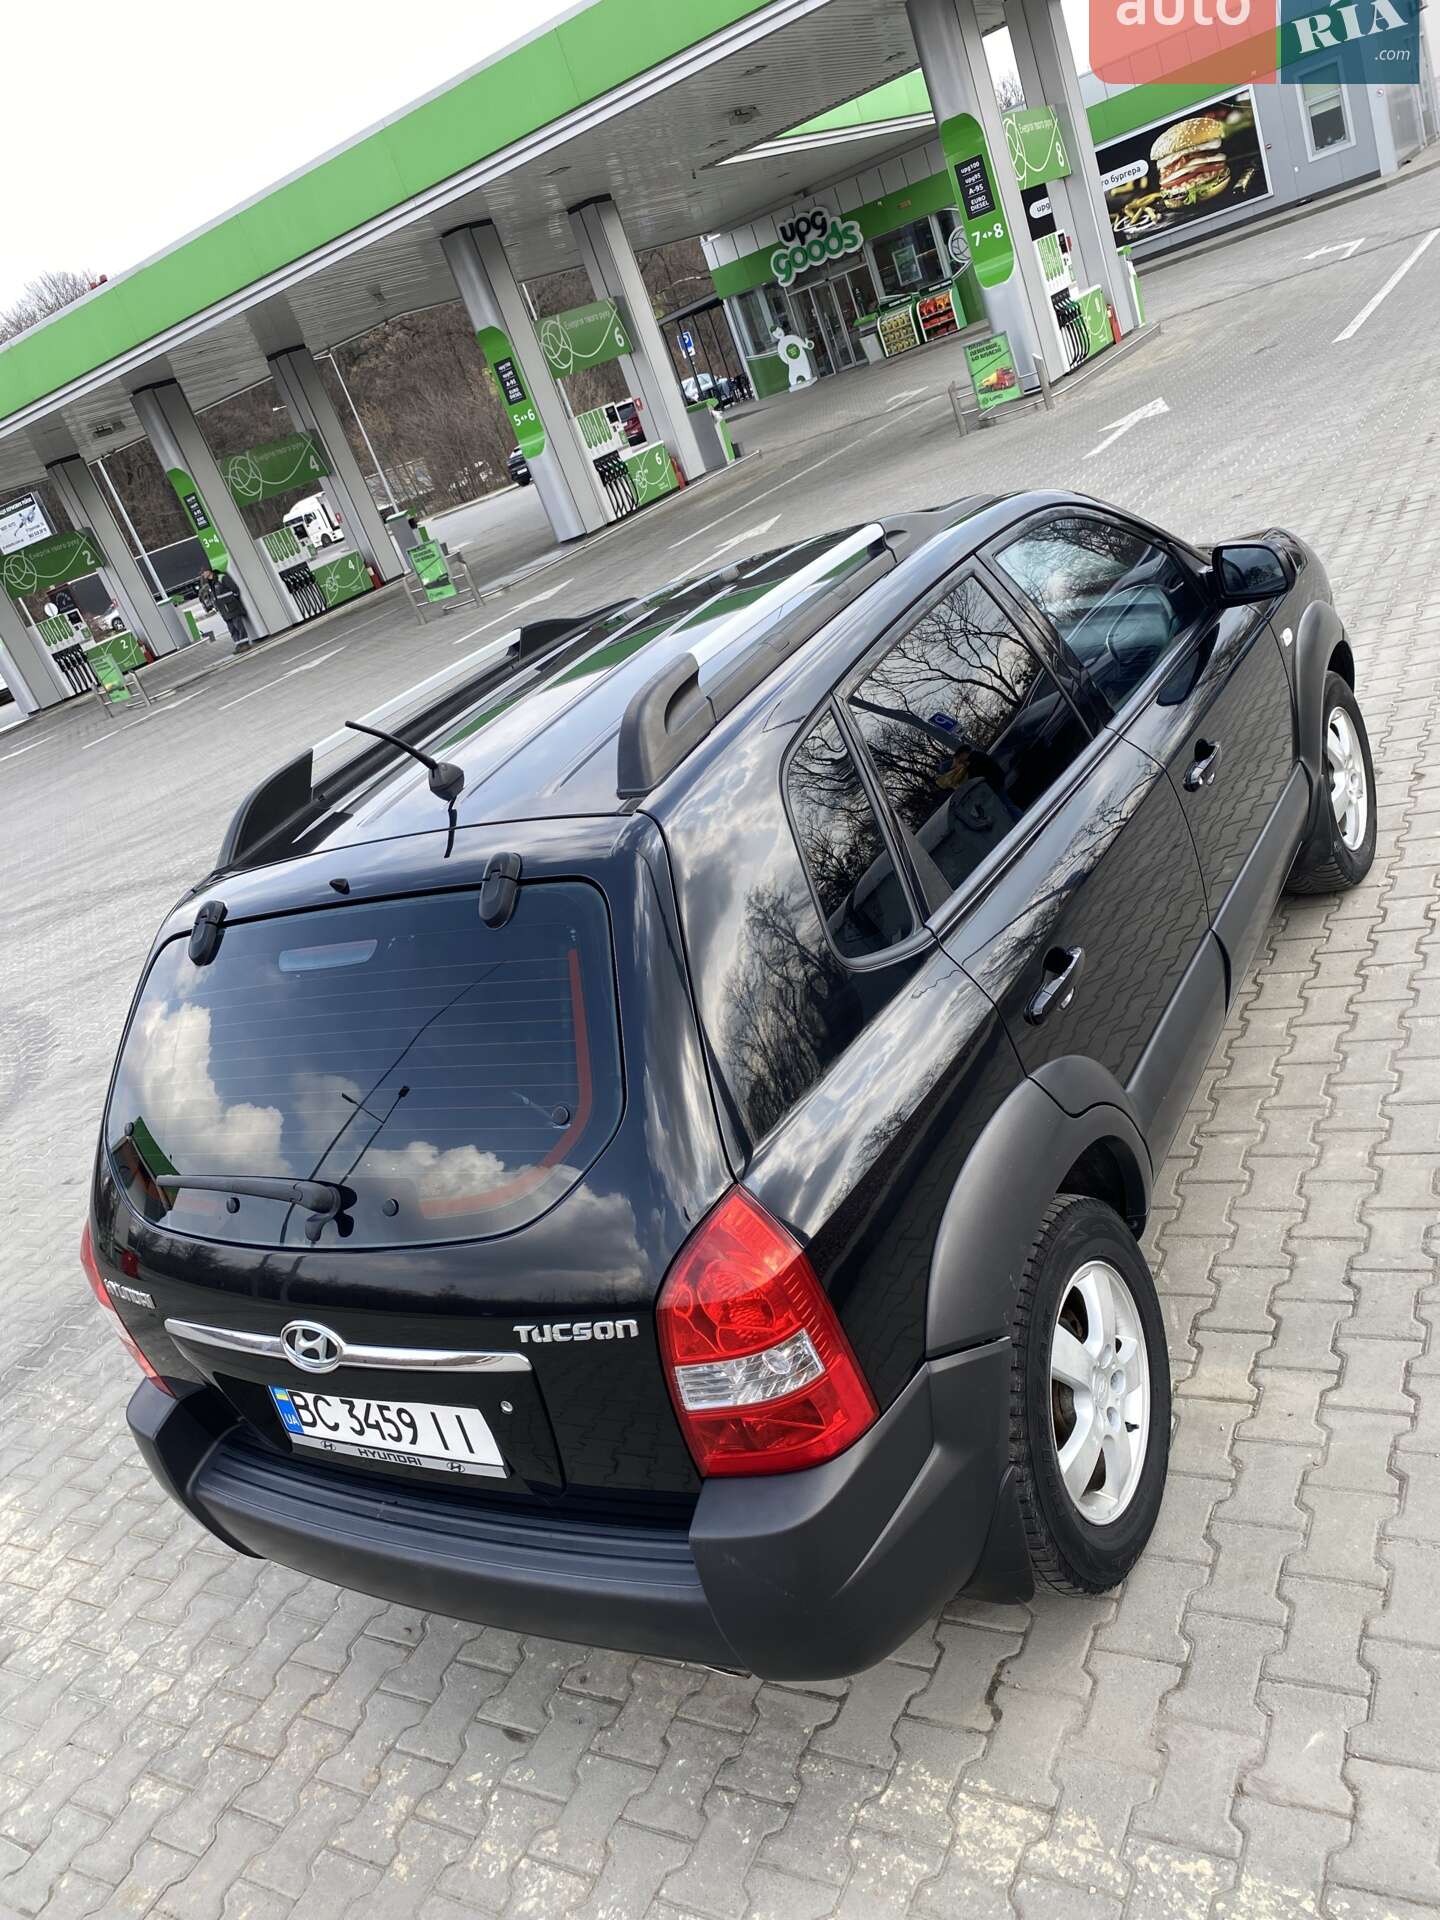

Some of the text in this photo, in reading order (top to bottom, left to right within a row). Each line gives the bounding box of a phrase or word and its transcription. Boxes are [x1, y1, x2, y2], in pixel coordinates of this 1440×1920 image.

[1055, 141, 1065, 168] 8
[1110, 166, 1141, 183] бургера
[779, 211, 828, 246] upg
[971, 223, 1004, 247] 7 8
[773, 220, 859, 283] goods
[614, 326, 625, 348] 6
[513, 408, 536, 427] 5 6
[309, 455, 320, 471] 4
[655, 451, 663, 465] 6
[82, 550, 95, 566] 2
[348, 559, 355, 571] 4
[120, 639, 128, 649] 2
[512, 1319, 640, 1343] TUCSON
[285, 1413, 300, 1426] UA
[288, 1390, 340, 1432] BC
[339, 1398, 419, 1446] 3459
[357, 1447, 423, 1466] HYUNDAI
